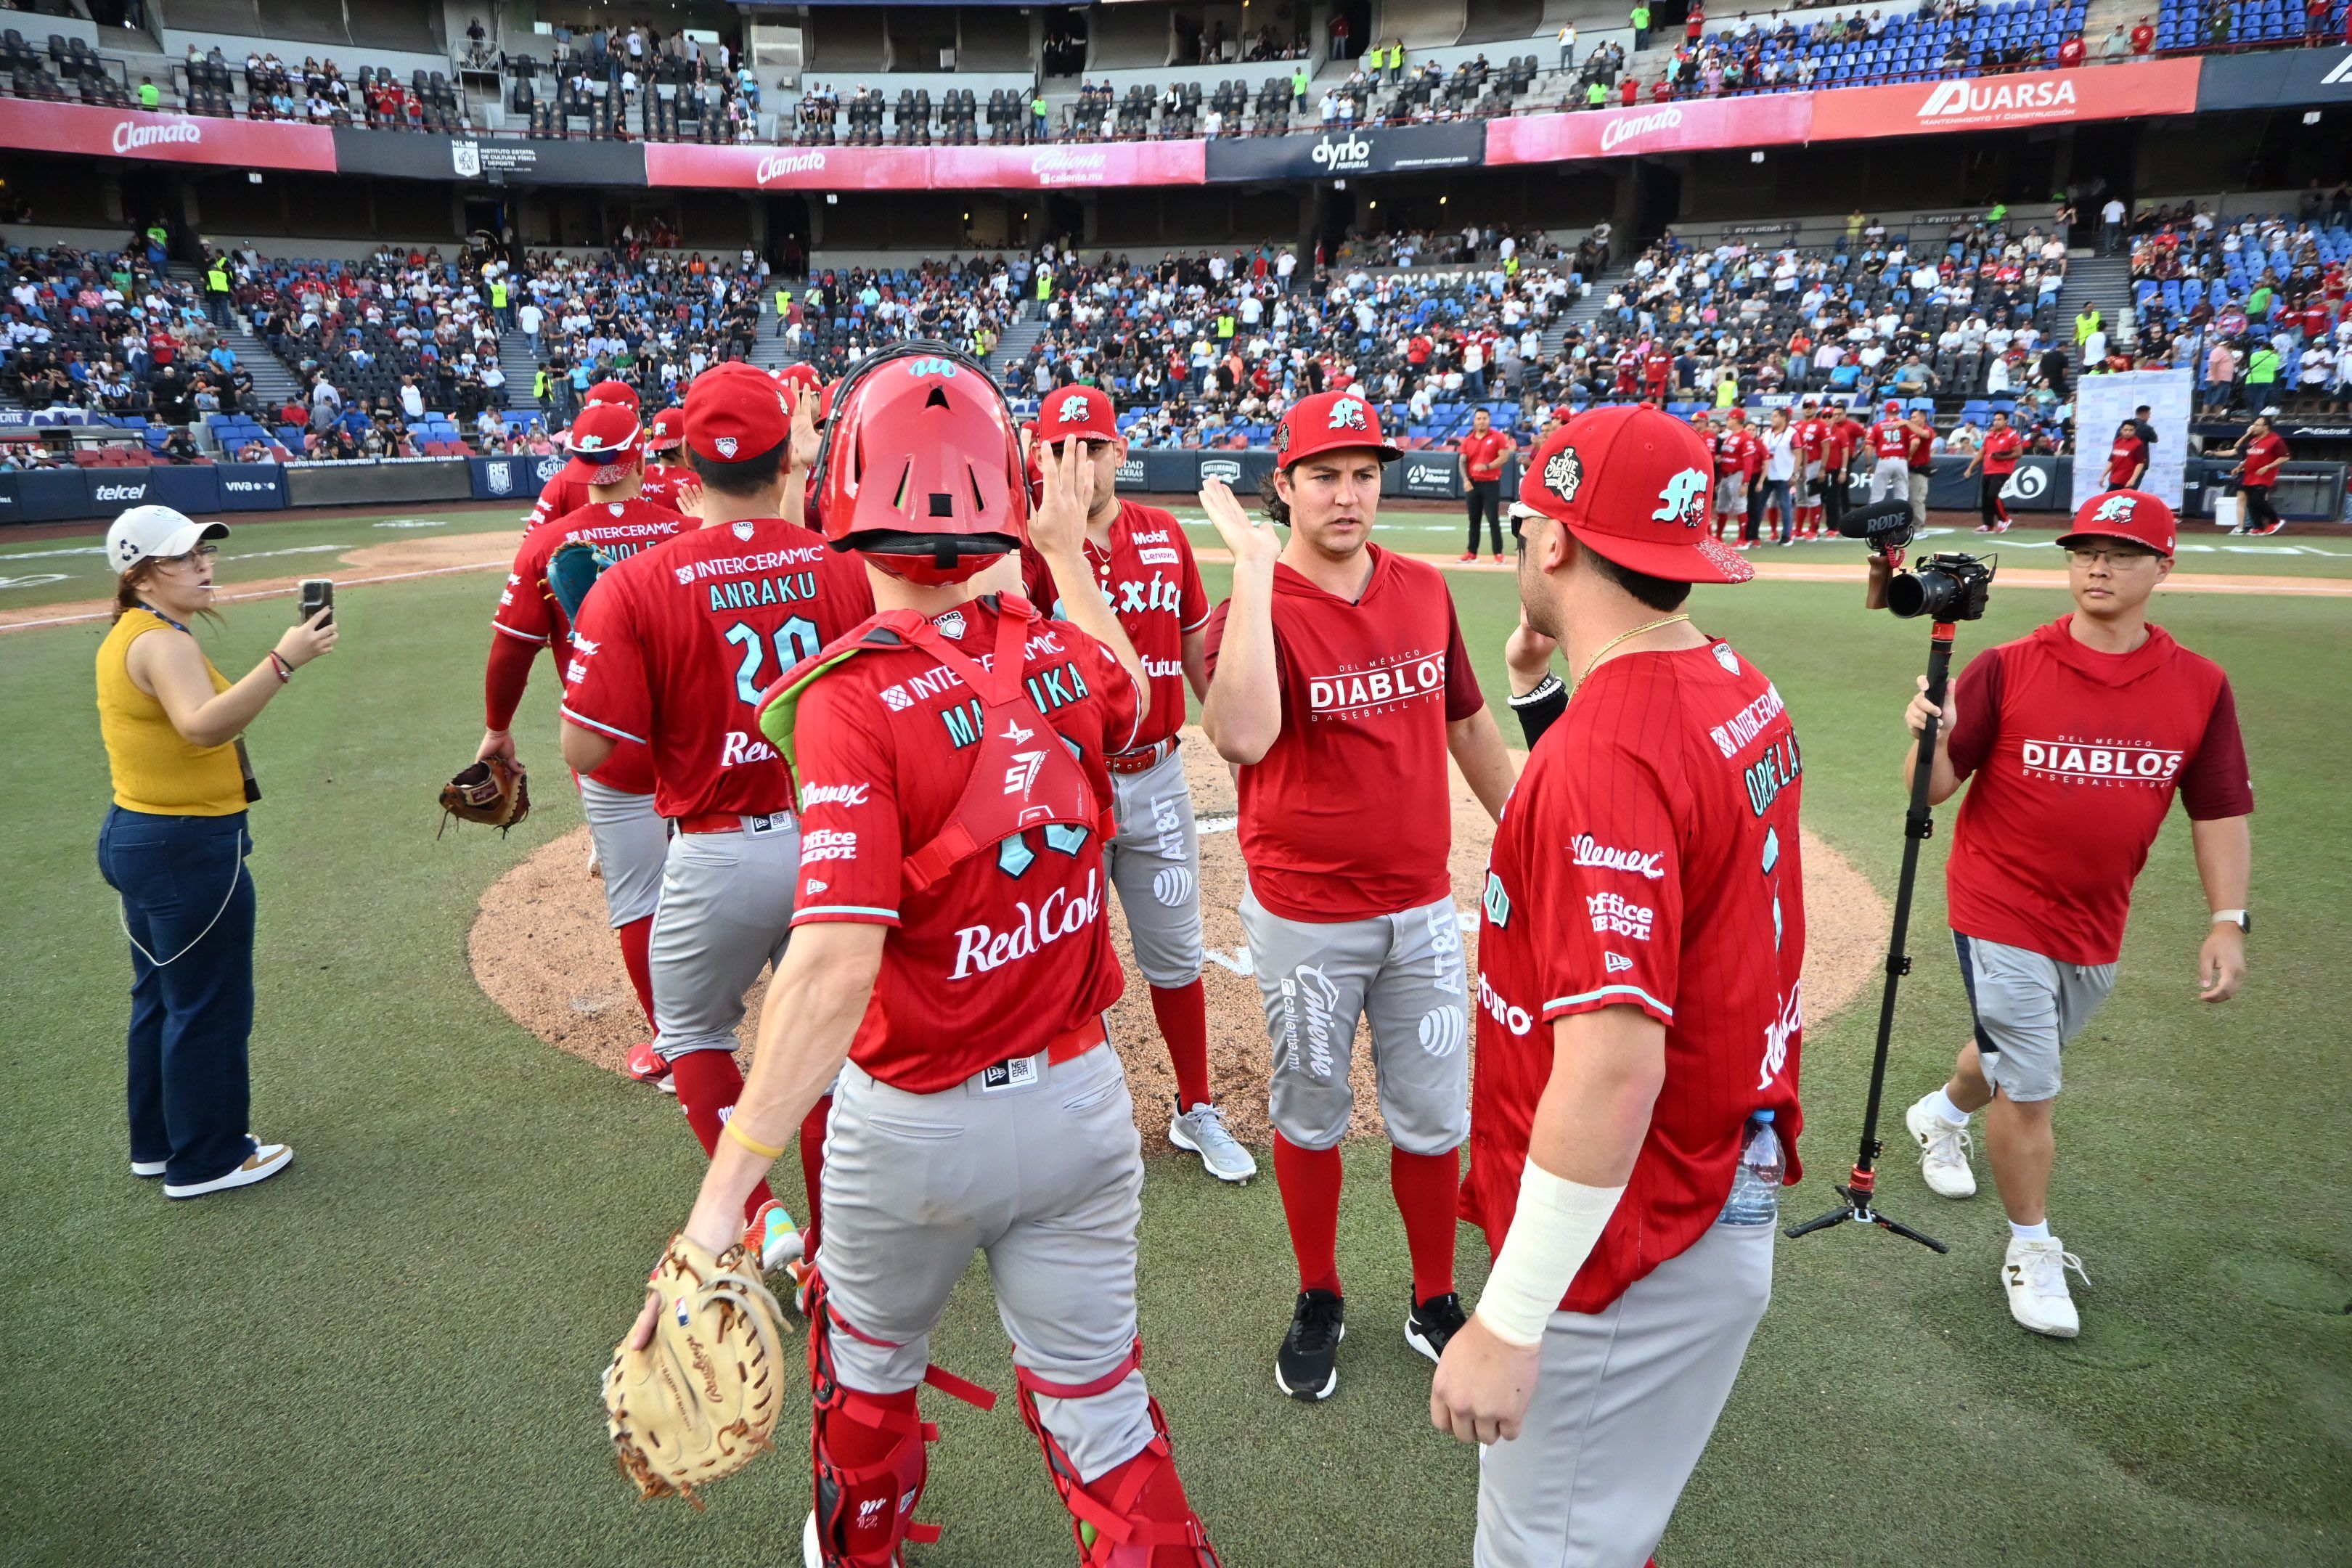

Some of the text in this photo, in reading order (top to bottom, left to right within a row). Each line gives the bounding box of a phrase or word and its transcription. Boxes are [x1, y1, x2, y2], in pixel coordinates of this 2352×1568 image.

[112, 121, 200, 154] Clamato
[1601, 107, 1682, 151] Clamato
[757, 150, 826, 184] Clamato
[1032, 149, 1106, 173] Caliente
[1336, 160, 1368, 170] PINTURAS
[1545, 456, 1578, 478] SERIE
[96, 484, 146, 501] telcel
[582, 520, 679, 540] INTERCERAMIC
[1866, 511, 1906, 533] RØDE
[1132, 530, 1169, 544] Mobil
[695, 545, 823, 578] INTERCERAMIC
[710, 571, 817, 612] ANRAKU
[1369, 649, 1420, 668] MÉXICO
[1310, 656, 1445, 708] DIABLOS
[1312, 701, 1408, 722] BASEBALL
[2059, 735, 2152, 748] DEL MÉXICO
[2023, 743, 2181, 776] DIABLOS
[2023, 769, 2125, 788] BASEBALL
[1151, 799, 1187, 861] AT&T
[1426, 910, 1461, 995] AT&T
[1296, 963, 1340, 1077] Caliente
[1283, 995, 1301, 1072] caliente.mx
[1011, 1059, 1027, 1070] NEW
[1012, 1067, 1028, 1077] ERA
